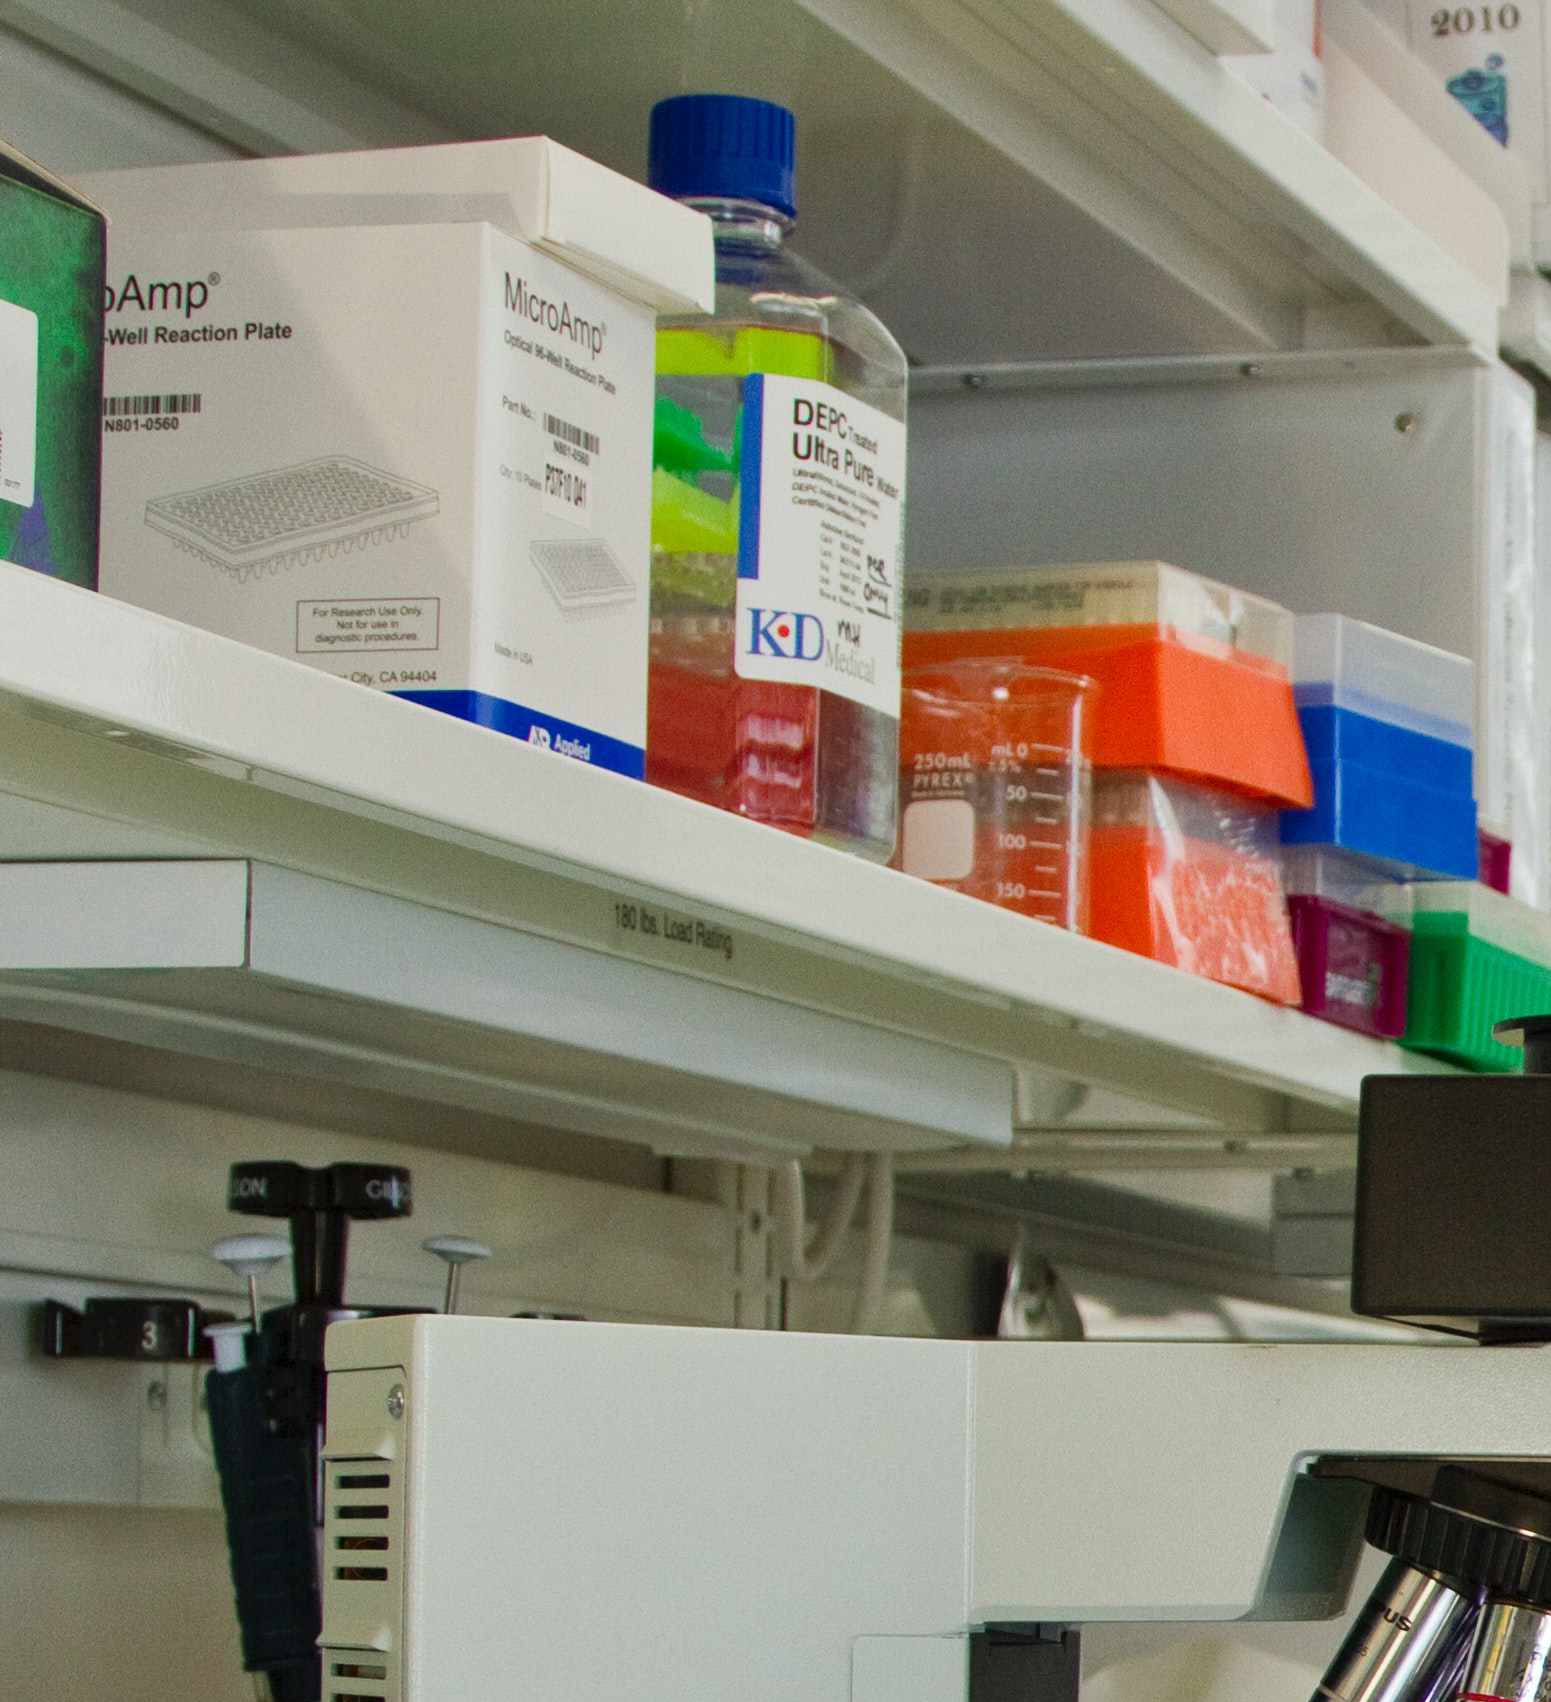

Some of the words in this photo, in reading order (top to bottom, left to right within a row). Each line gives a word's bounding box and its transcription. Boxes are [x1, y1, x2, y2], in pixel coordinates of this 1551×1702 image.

[1430, 3, 1520, 36] 2010
[154, 324, 238, 344] Reaction
[244, 321, 293, 340] Plate
[504, 329, 533, 354] Optical
[564, 357, 597, 386] Reaction
[598, 374, 617, 396] Plate
[502, 395, 519, 413] Part
[104, 416, 179, 433] N801-0560
[794, 398, 848, 440] DEPC
[793, 431, 839, 470] Ultra
[844, 448, 874, 487] Pure
[312, 608, 328, 618] For
[331, 607, 376, 617] Research
[378, 607, 397, 616] Use
[336, 620, 353, 629] Not
[355, 619, 368, 629] for
[371, 621, 388, 629] use
[390, 619, 399, 629] in
[314, 633, 362, 645] diagnostic
[825, 638, 875, 684] Medical
[379, 672, 397, 683] CA
[401, 671, 437, 682] 94404
[914, 753, 971, 770] 250mL
[1007, 785, 1028, 802] 50
[998, 834, 1026, 849] 100
[997, 883, 1026, 899] 150
[664, 912, 693, 944] Load
[142, 1320, 158, 1350] 3
